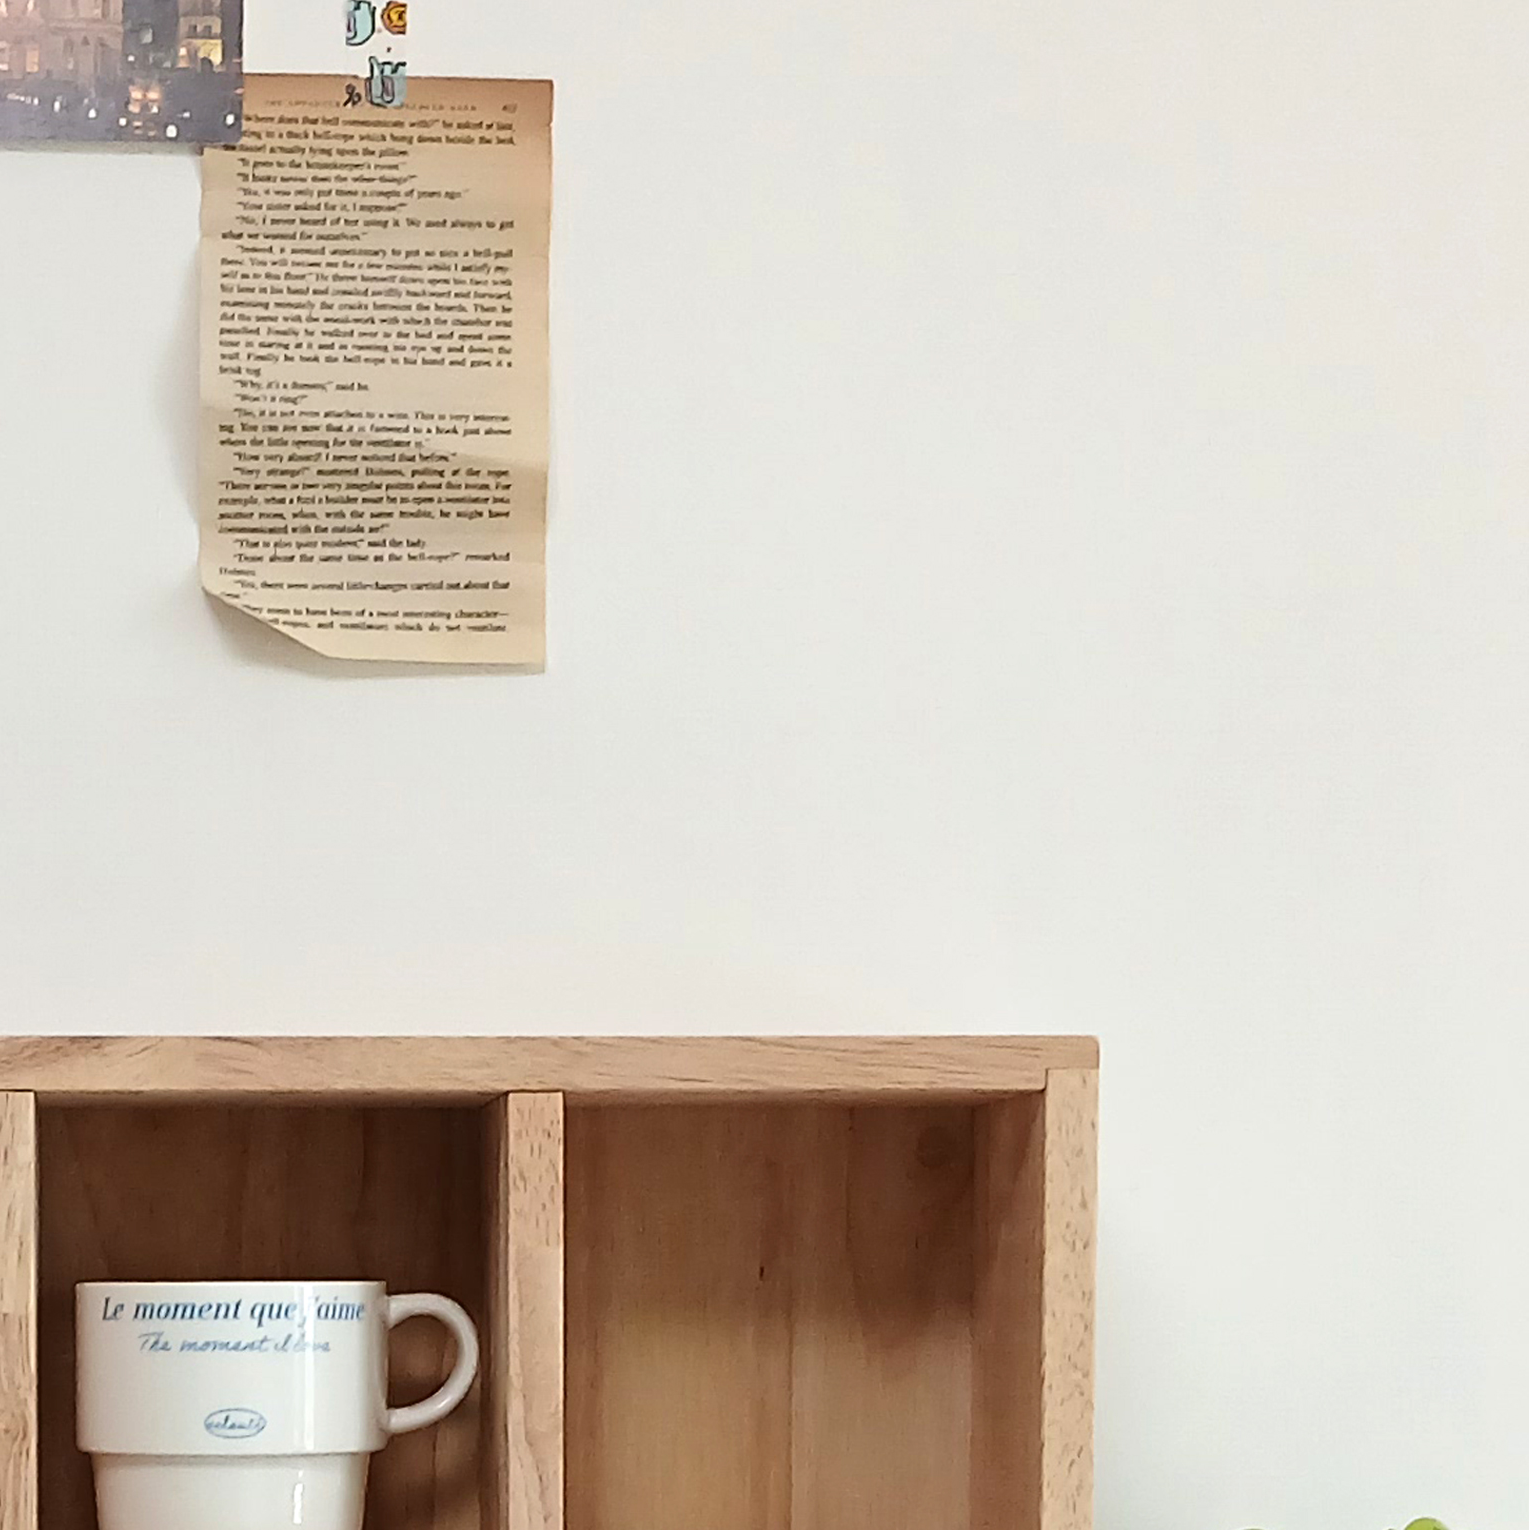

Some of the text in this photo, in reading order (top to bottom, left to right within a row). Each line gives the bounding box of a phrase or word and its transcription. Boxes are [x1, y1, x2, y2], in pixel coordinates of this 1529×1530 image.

[102, 1297, 125, 1321] Le
[133, 1299, 242, 1320] moment
[250, 1302, 297, 1328] que
[138, 1332, 172, 1351] The
[179, 1335, 271, 1352] moment
